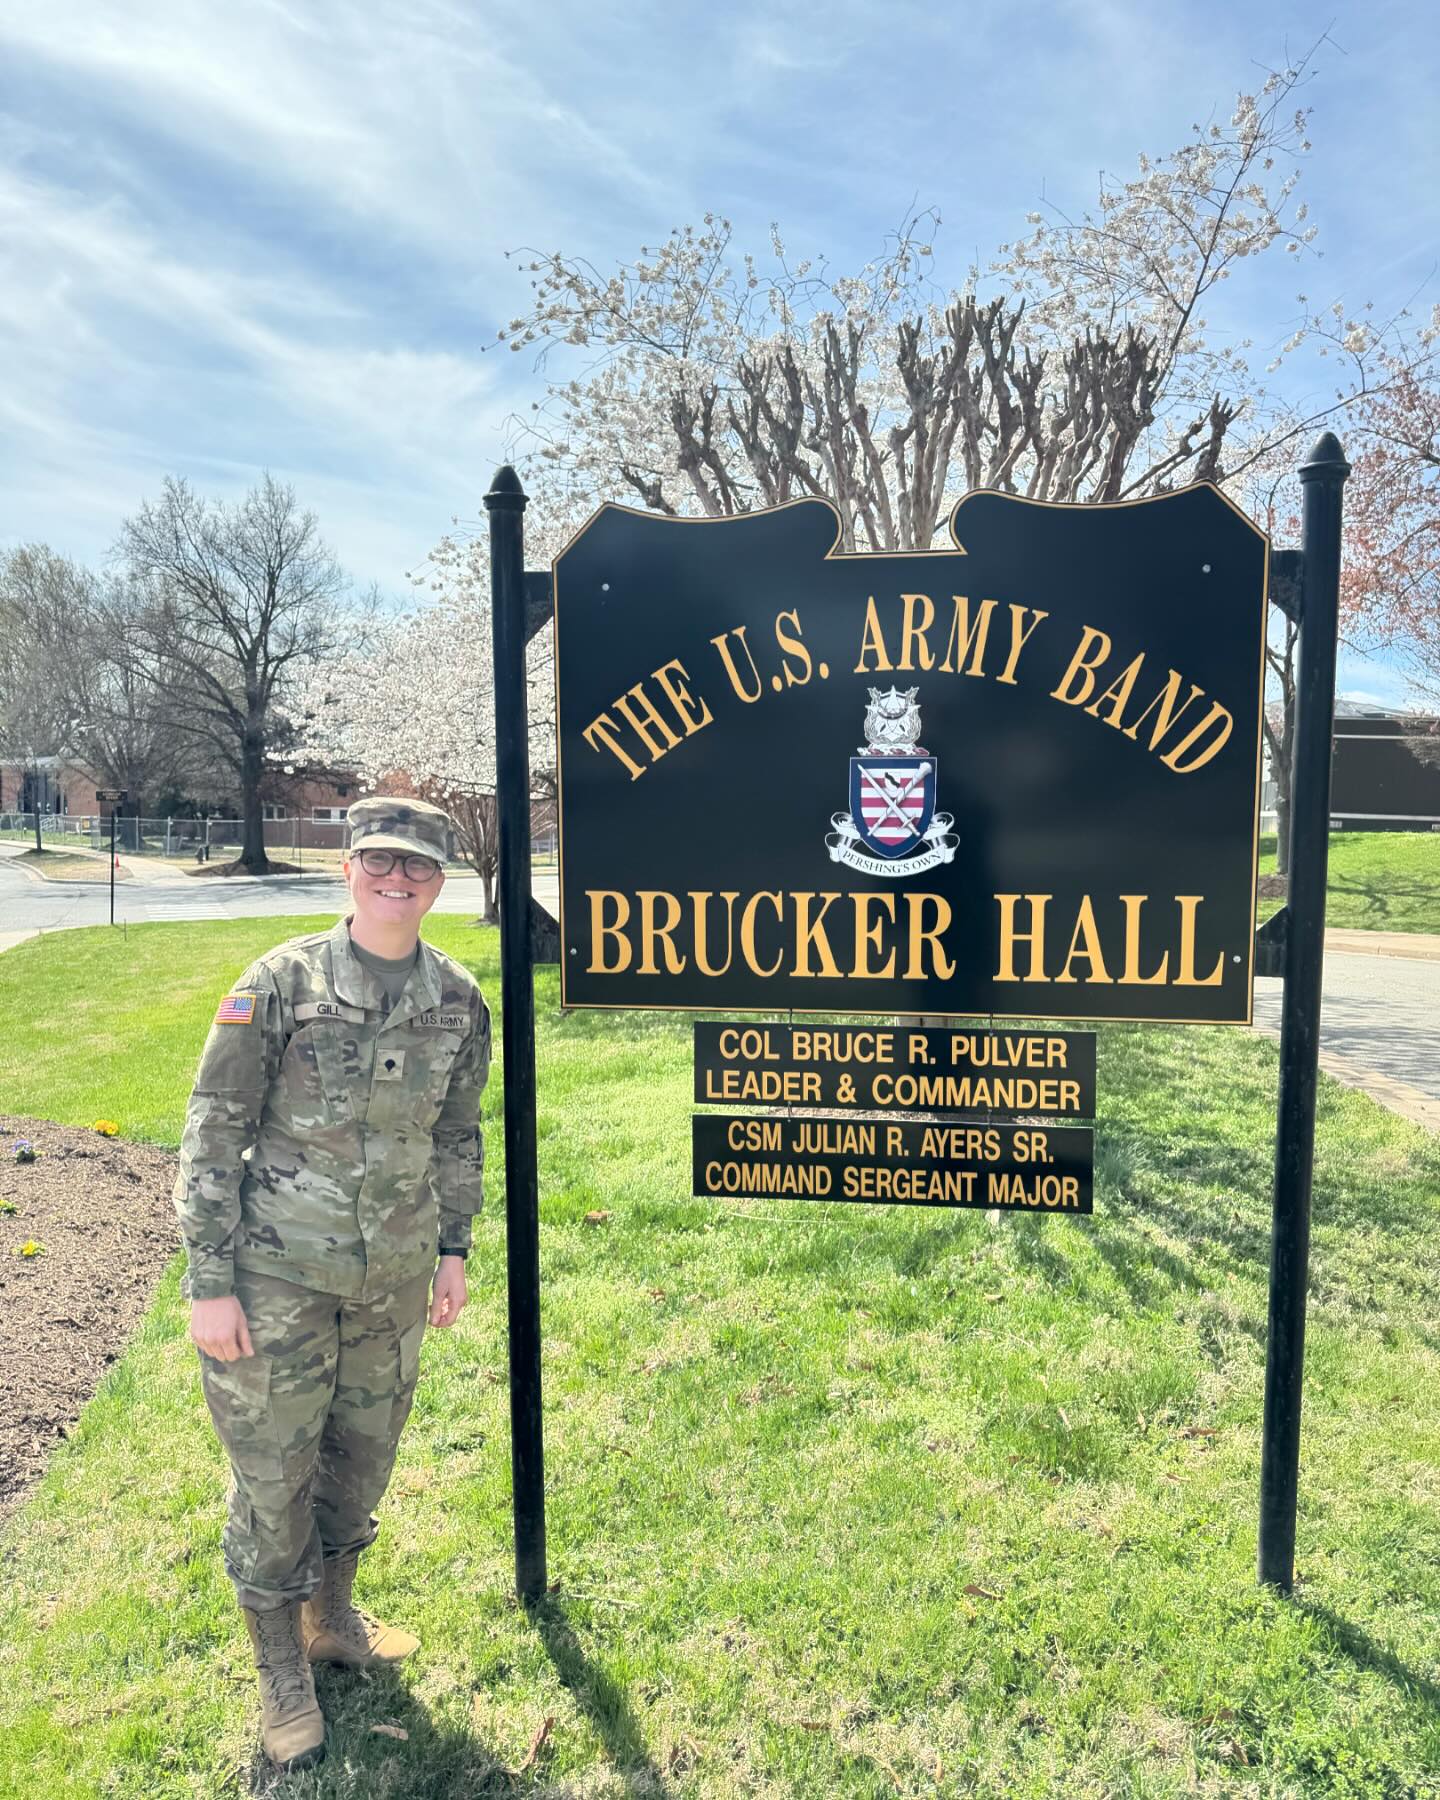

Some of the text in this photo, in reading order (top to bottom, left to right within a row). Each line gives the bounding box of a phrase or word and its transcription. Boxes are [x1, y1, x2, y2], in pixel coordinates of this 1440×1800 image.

[583, 595, 1234, 782] THE U.S. ARMY BAND
[843, 851, 941, 873] PERSHING'S OWN
[586, 891, 1225, 986] BRUCKER HALL
[317, 1003, 342, 1017] GILL
[440, 1017, 464, 1027] ARMY
[719, 1029, 1068, 1068] COL BRUCE R. PULVER
[706, 1070, 1081, 1111] LEADER & COMMANDER
[727, 1121, 1054, 1163] CSM JULIAN R. AYERS SR.
[705, 1161, 1079, 1207] COMMAND SERGEANT MAJOR
